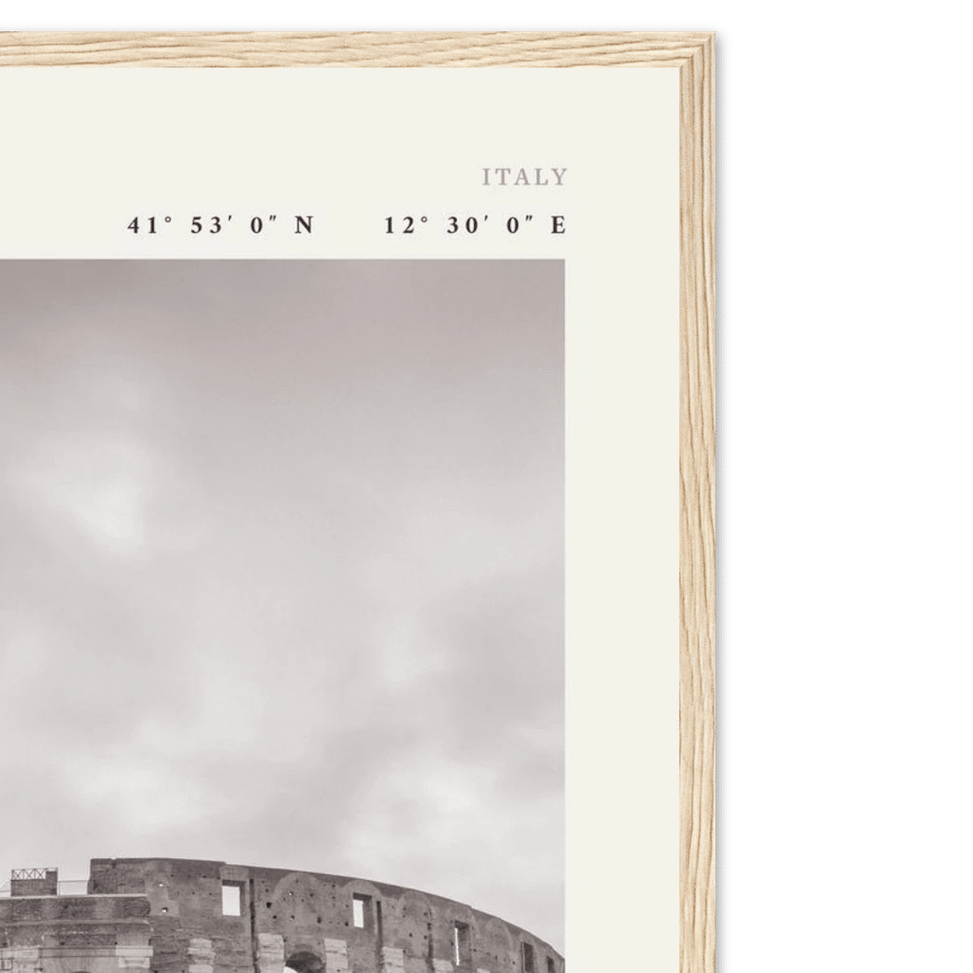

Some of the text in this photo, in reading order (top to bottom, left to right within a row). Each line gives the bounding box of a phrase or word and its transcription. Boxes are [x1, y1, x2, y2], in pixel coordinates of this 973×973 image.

[483, 168, 567, 185] ITALY
[127, 216, 171, 234] 41°
[295, 216, 313, 234] N
[385, 216, 428, 234] 12°
[551, 216, 565, 234] E
